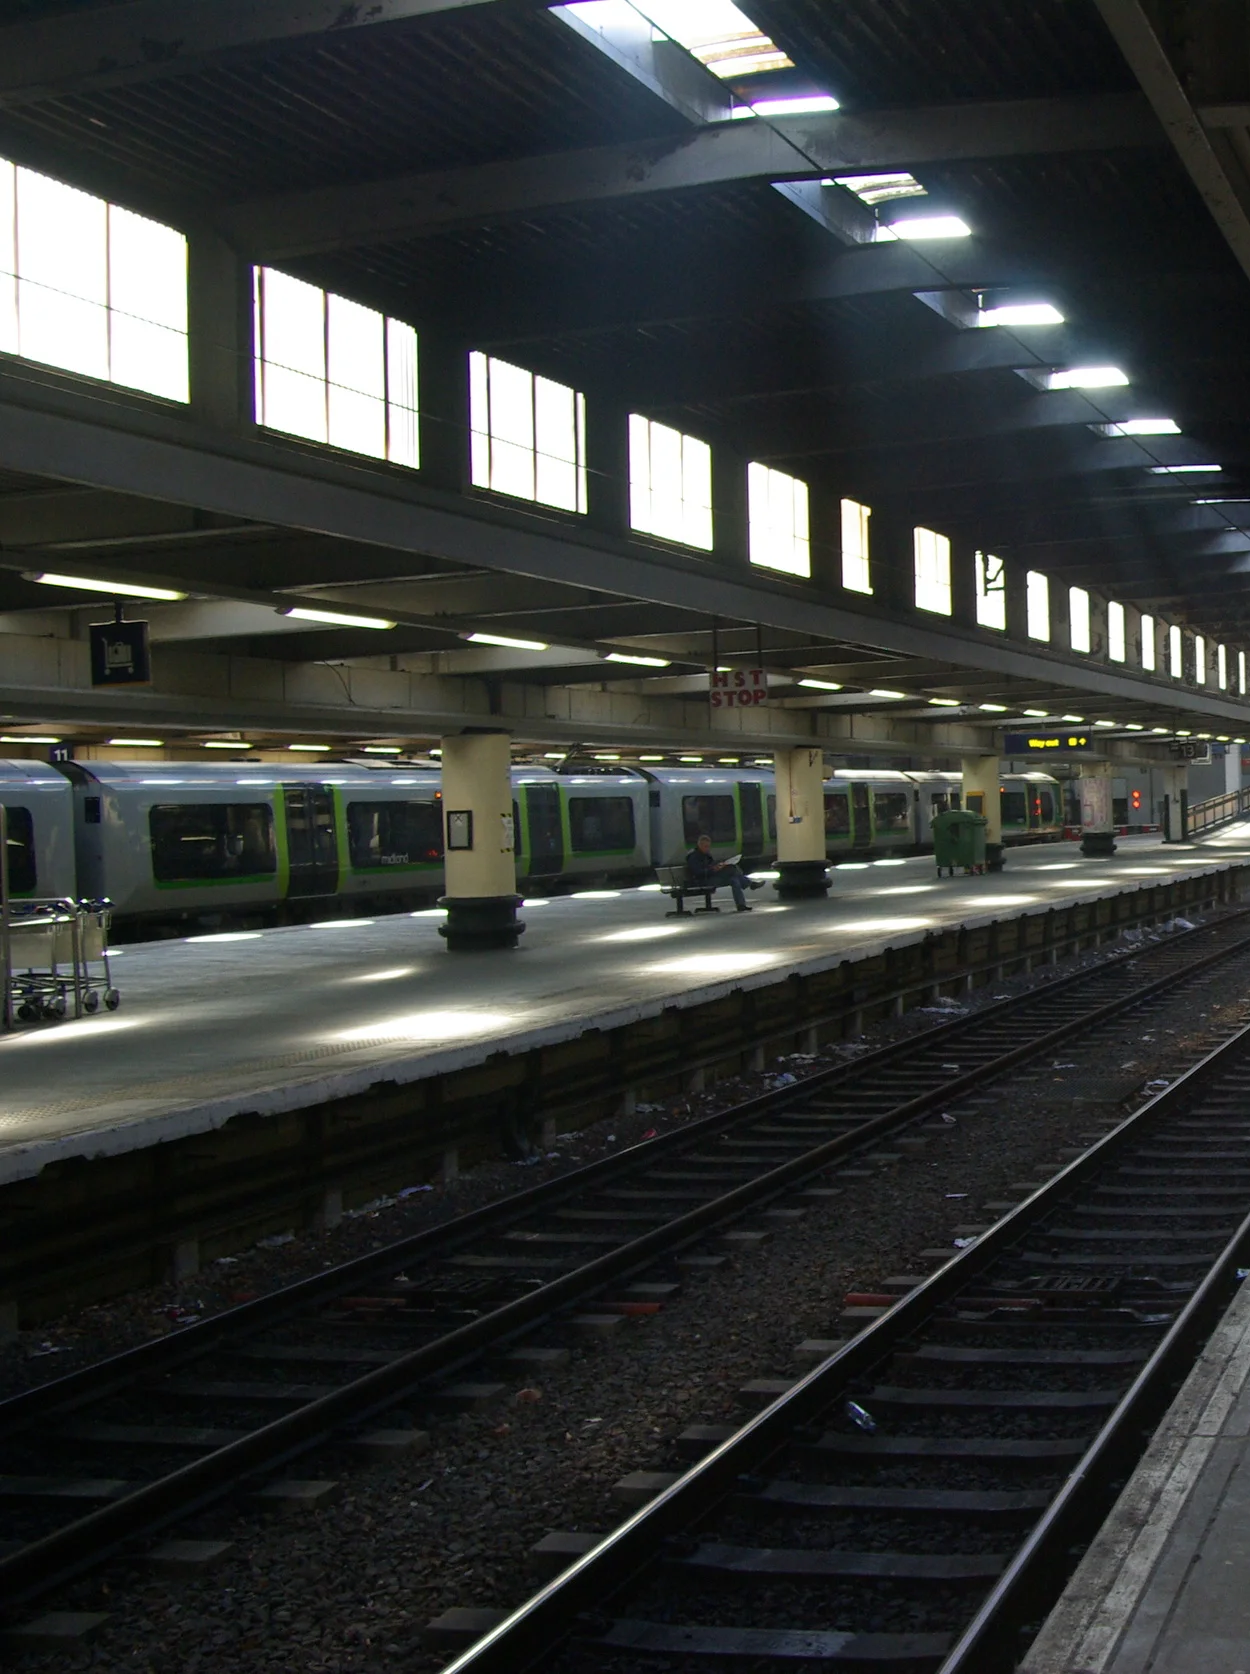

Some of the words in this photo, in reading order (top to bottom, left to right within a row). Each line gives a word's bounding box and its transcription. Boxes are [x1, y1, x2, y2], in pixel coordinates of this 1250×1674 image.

[711, 690, 766, 707] STOP
[53, 748, 68, 762] 11
[1181, 745, 1195, 758] 13
